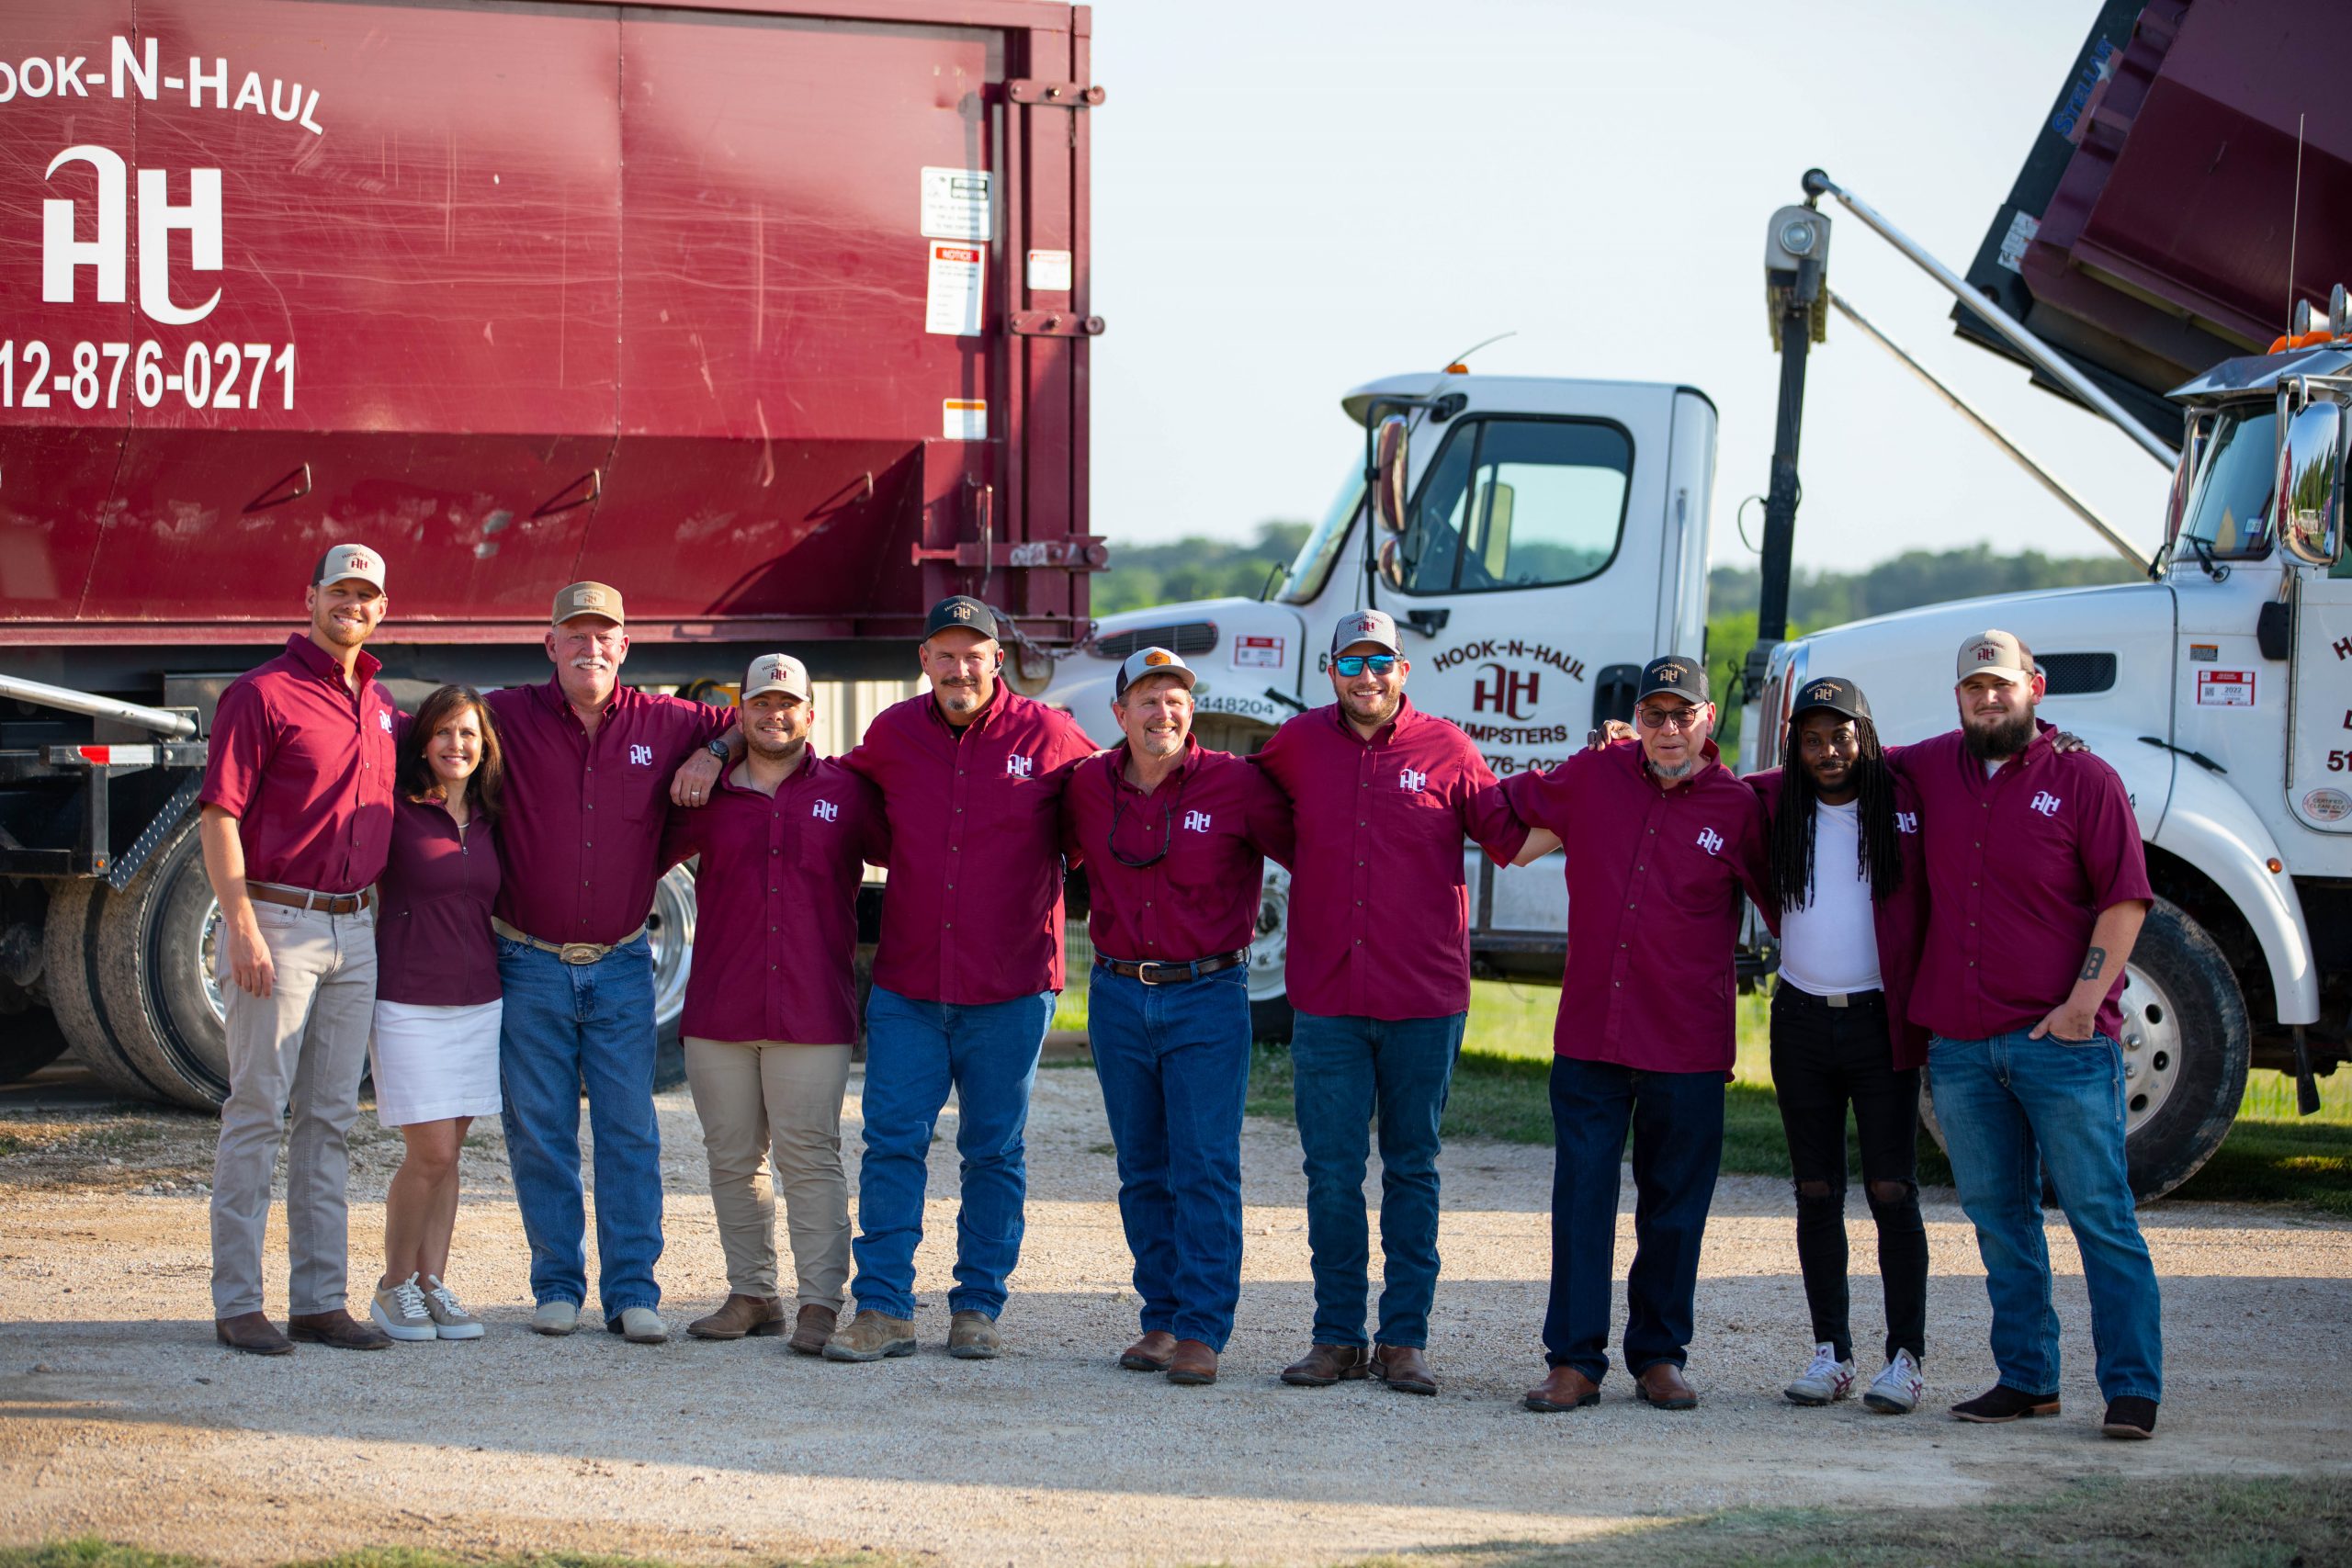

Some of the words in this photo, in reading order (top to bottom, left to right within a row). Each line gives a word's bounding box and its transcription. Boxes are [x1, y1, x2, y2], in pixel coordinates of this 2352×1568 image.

[2052, 38, 2114, 138] STELLAR
[942, 249, 973, 263] NOTICE
[1432, 639, 1586, 683] HOOK-N-HAUL
